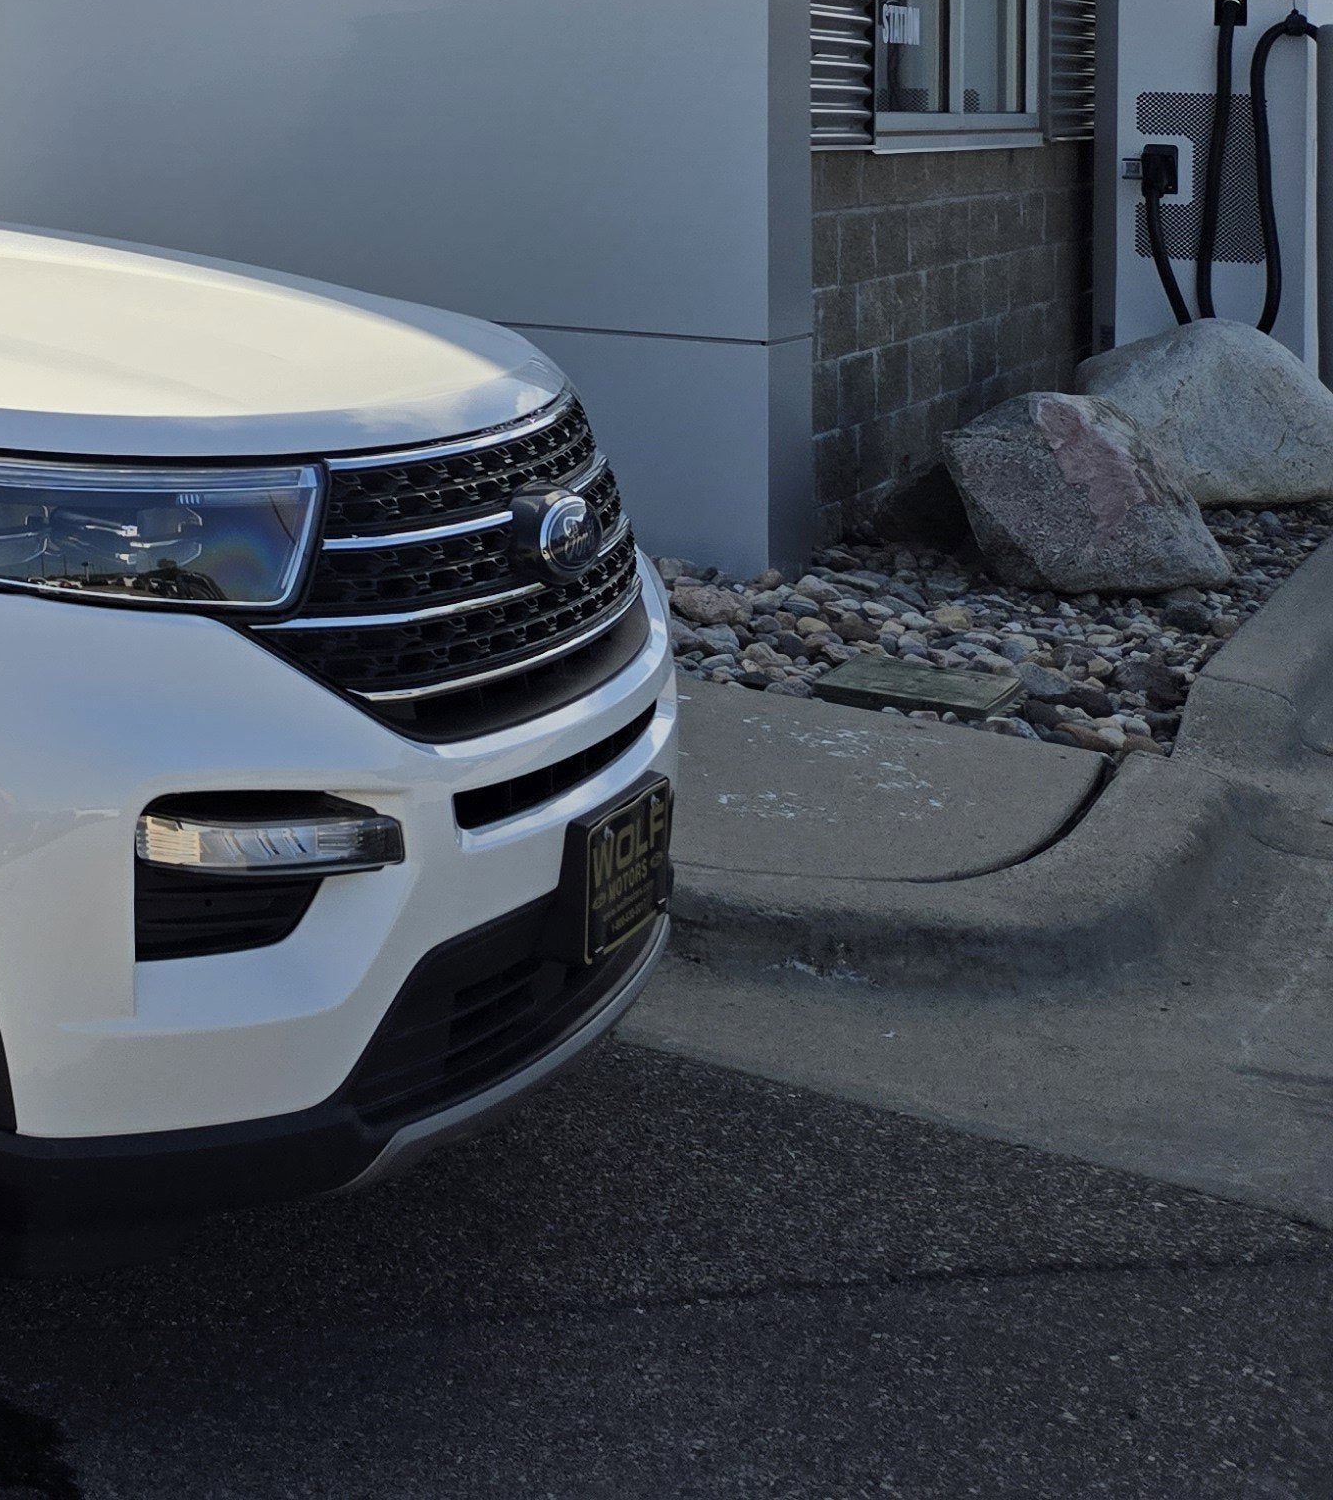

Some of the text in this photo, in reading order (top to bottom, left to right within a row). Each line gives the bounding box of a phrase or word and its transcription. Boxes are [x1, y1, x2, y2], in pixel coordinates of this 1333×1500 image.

[883, 3, 921, 46] STATION
[593, 799, 665, 889] WOLF
[607, 856, 649, 903] MOTORS
